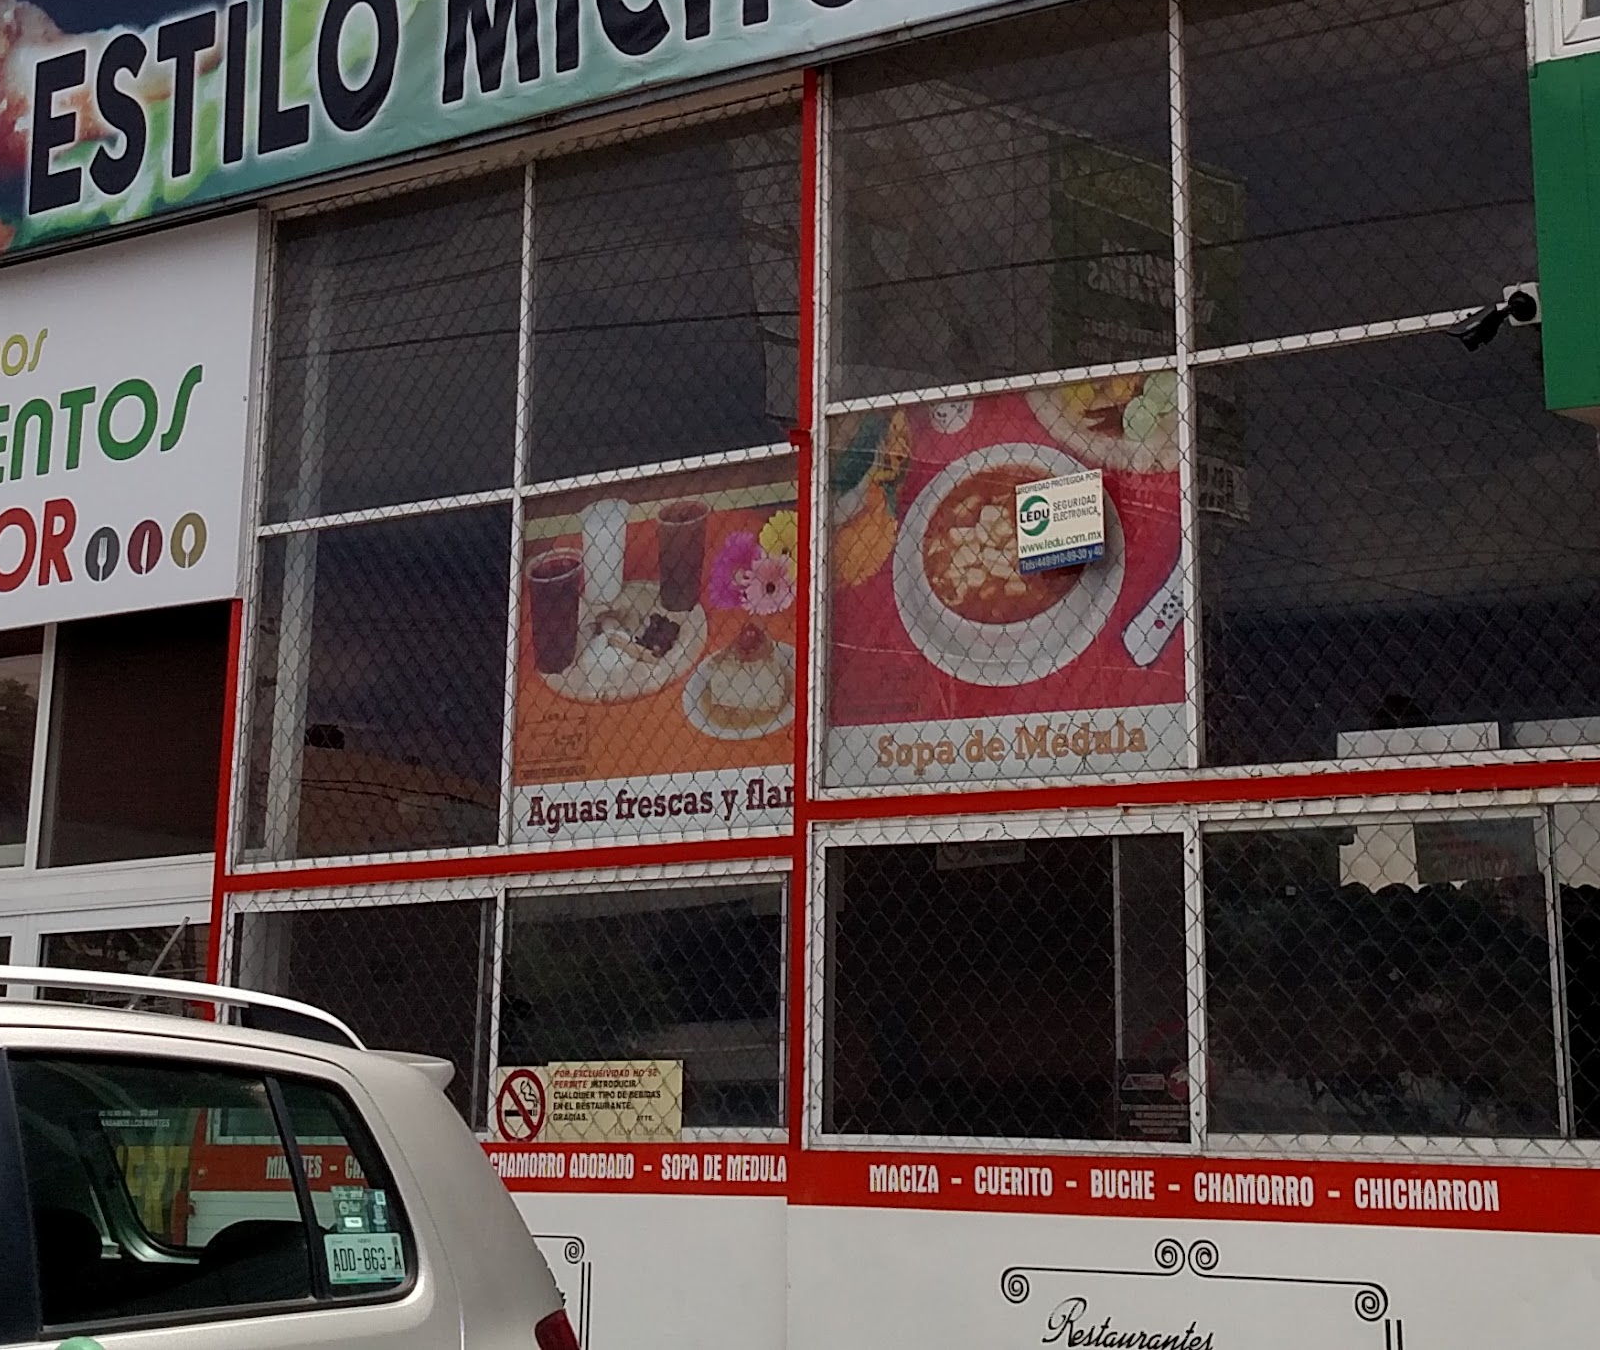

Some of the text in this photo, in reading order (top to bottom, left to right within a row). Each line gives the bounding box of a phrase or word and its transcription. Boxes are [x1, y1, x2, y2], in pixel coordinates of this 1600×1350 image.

[1020, 507, 1051, 524] LEDU
[1052, 494, 1097, 512] SEGURIDAD
[1019, 530, 1102, 554] www.ledu.com.mx
[876, 719, 1149, 776] Sopa de Médula
[526, 796, 608, 833] Aguas
[614, 788, 713, 820] frescas
[720, 788, 738, 821] y
[554, 1069, 570, 1078] POR
[573, 1069, 630, 1078] EXCLUSIVIDAD
[553, 1090, 596, 1099] CUALQUIER
[598, 1090, 615, 1099] TIPO
[617, 1090, 627, 1099] DE
[553, 1102, 564, 1110] EN
[564, 1102, 574, 1110] EL
[569, 1153, 635, 1180] ADOBADO
[661, 1153, 699, 1181] SOPA
[703, 1154, 722, 1181] DE
[726, 1154, 788, 1183] MEDULA
[868, 1164, 940, 1195] MACIZA
[973, 1167, 1054, 1198] CUERITO
[1090, 1169, 1156, 1201] BUCHE
[1193, 1171, 1315, 1209] CHAMORRO
[1353, 1176, 1500, 1213] CHICHARRON
[333, 1246, 403, 1272] ADD-863-A
[1041, 1296, 1215, 1349] Restaurantes
